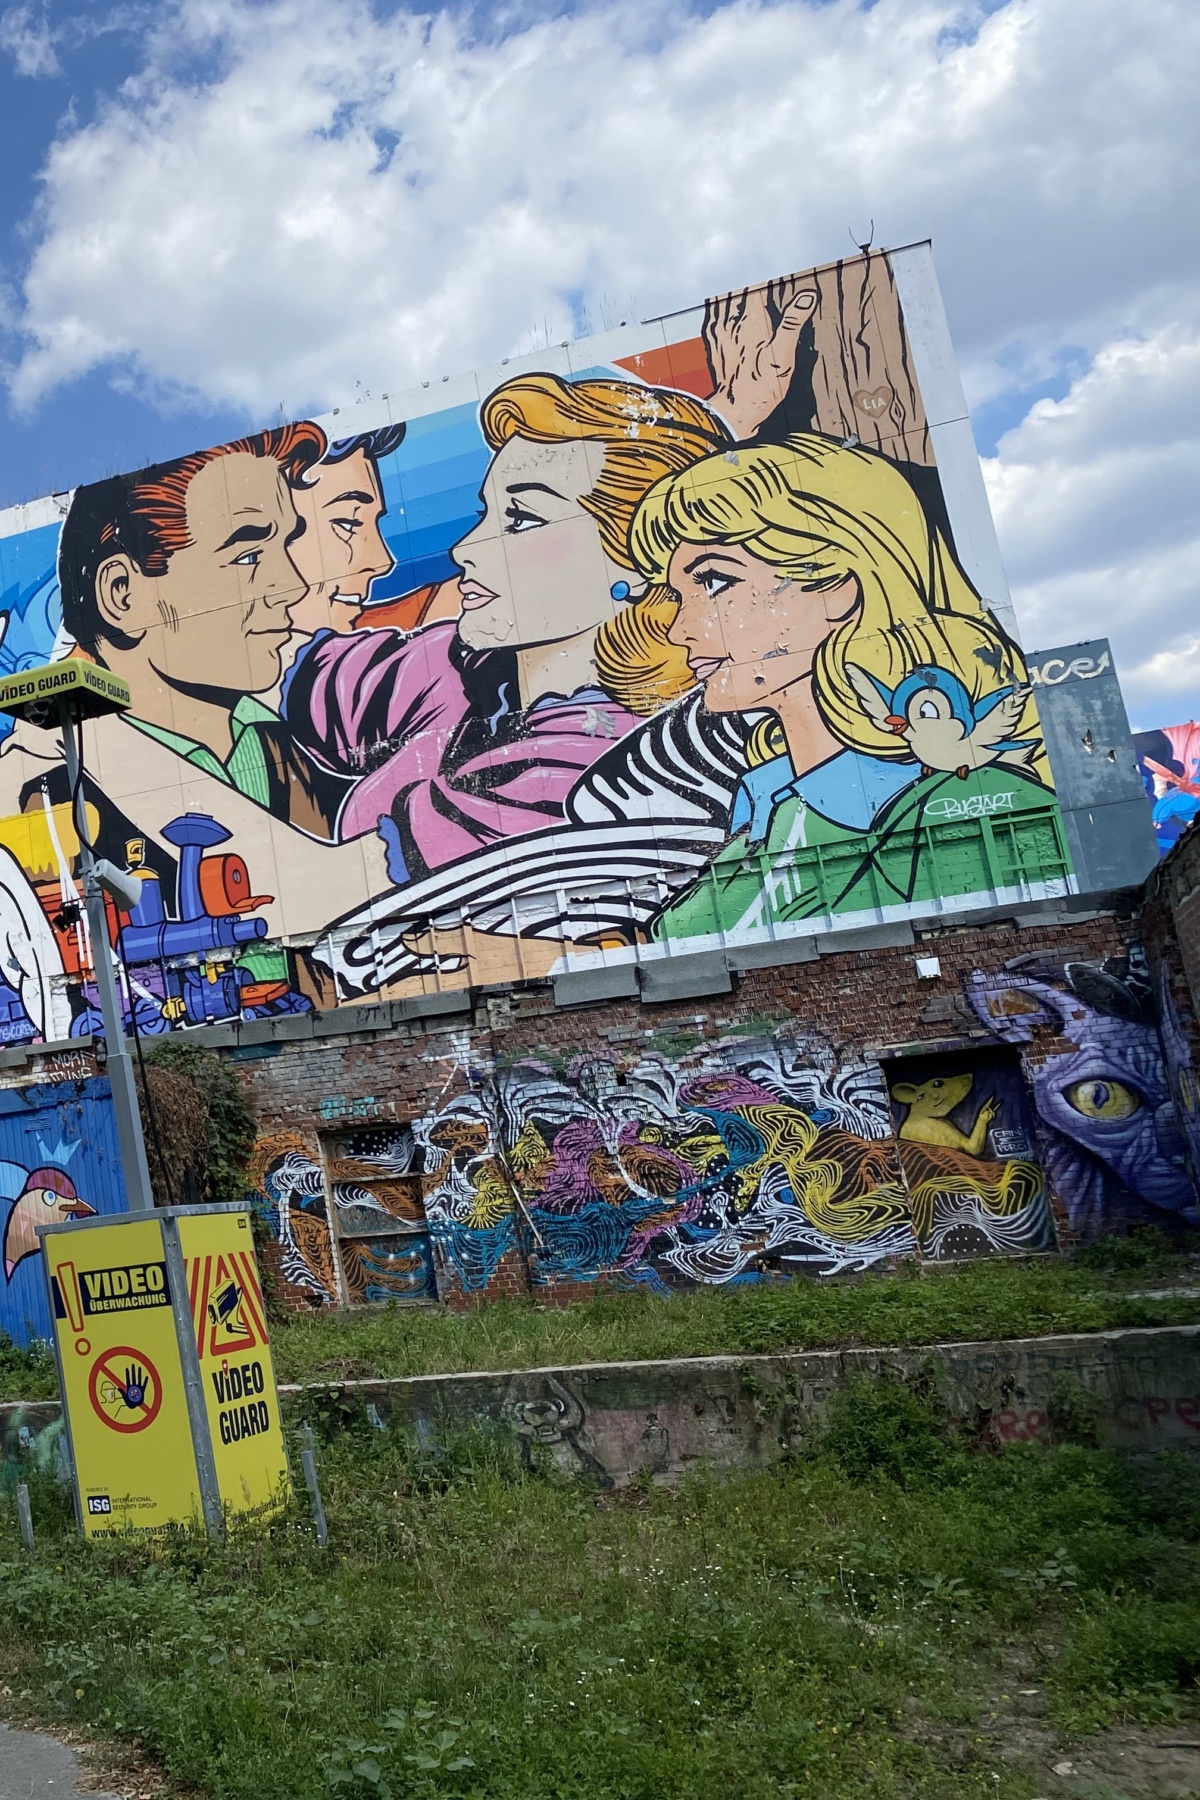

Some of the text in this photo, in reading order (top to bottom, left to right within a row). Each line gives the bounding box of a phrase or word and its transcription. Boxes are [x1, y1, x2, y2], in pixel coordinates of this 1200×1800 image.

[862, 397, 887, 410] LIA
[38, 670, 76, 692] GUARD
[83, 670, 130, 703] VIDEO GUARD
[924, 792, 1016, 819] BUSTART
[84, 1266, 164, 1298] VIDEO
[89, 1293, 167, 1312] ÜBERWACHUNG
[212, 1360, 264, 1404] VIDEO
[219, 1401, 270, 1445] GUARD
[89, 1499, 110, 1512] ISG
[138, 1502, 158, 1510] GROUP
